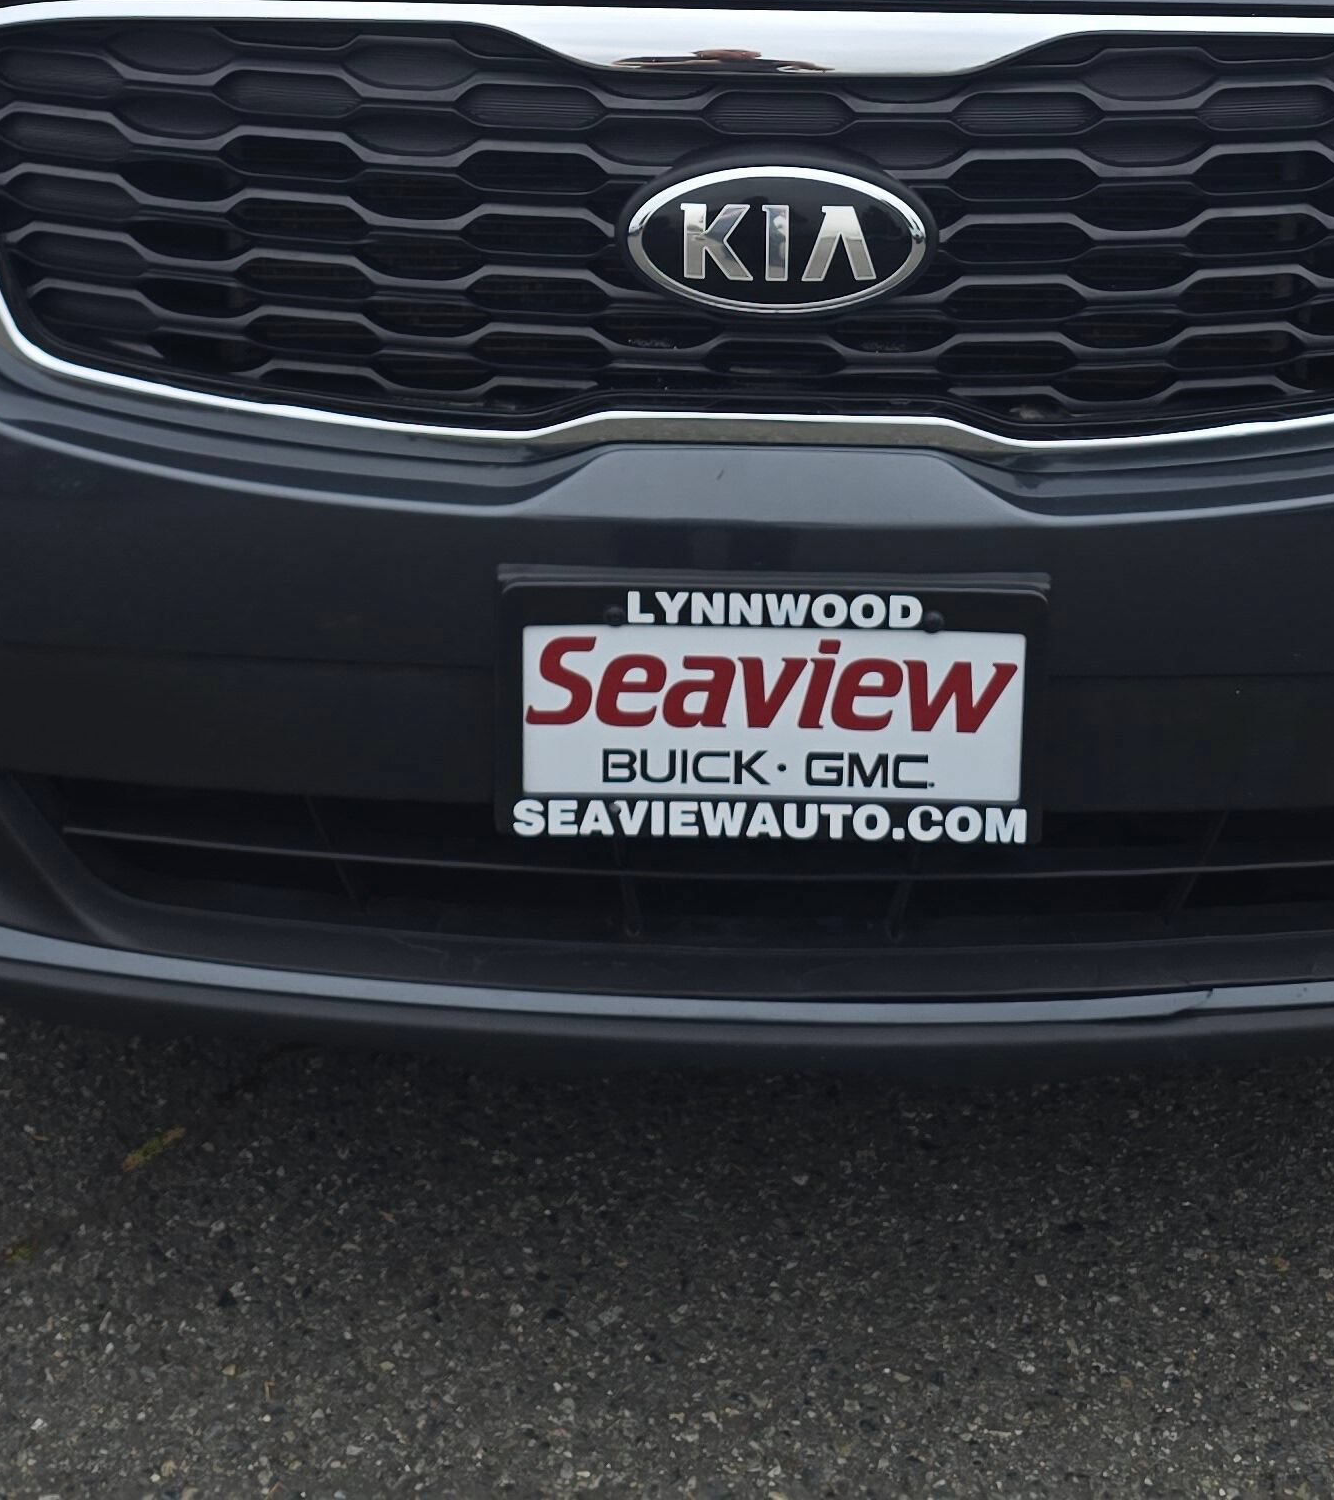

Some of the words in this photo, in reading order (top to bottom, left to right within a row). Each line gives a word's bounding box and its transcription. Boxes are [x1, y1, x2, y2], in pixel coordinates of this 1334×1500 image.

[680, 203, 877, 282] KIA
[627, 590, 923, 629] LYNNWOOD
[525, 636, 1018, 733] Seaview
[602, 748, 771, 785] BUICK
[805, 751, 935, 789] GMC
[512, 799, 1028, 844] SEAVIEWAUTO.COM
